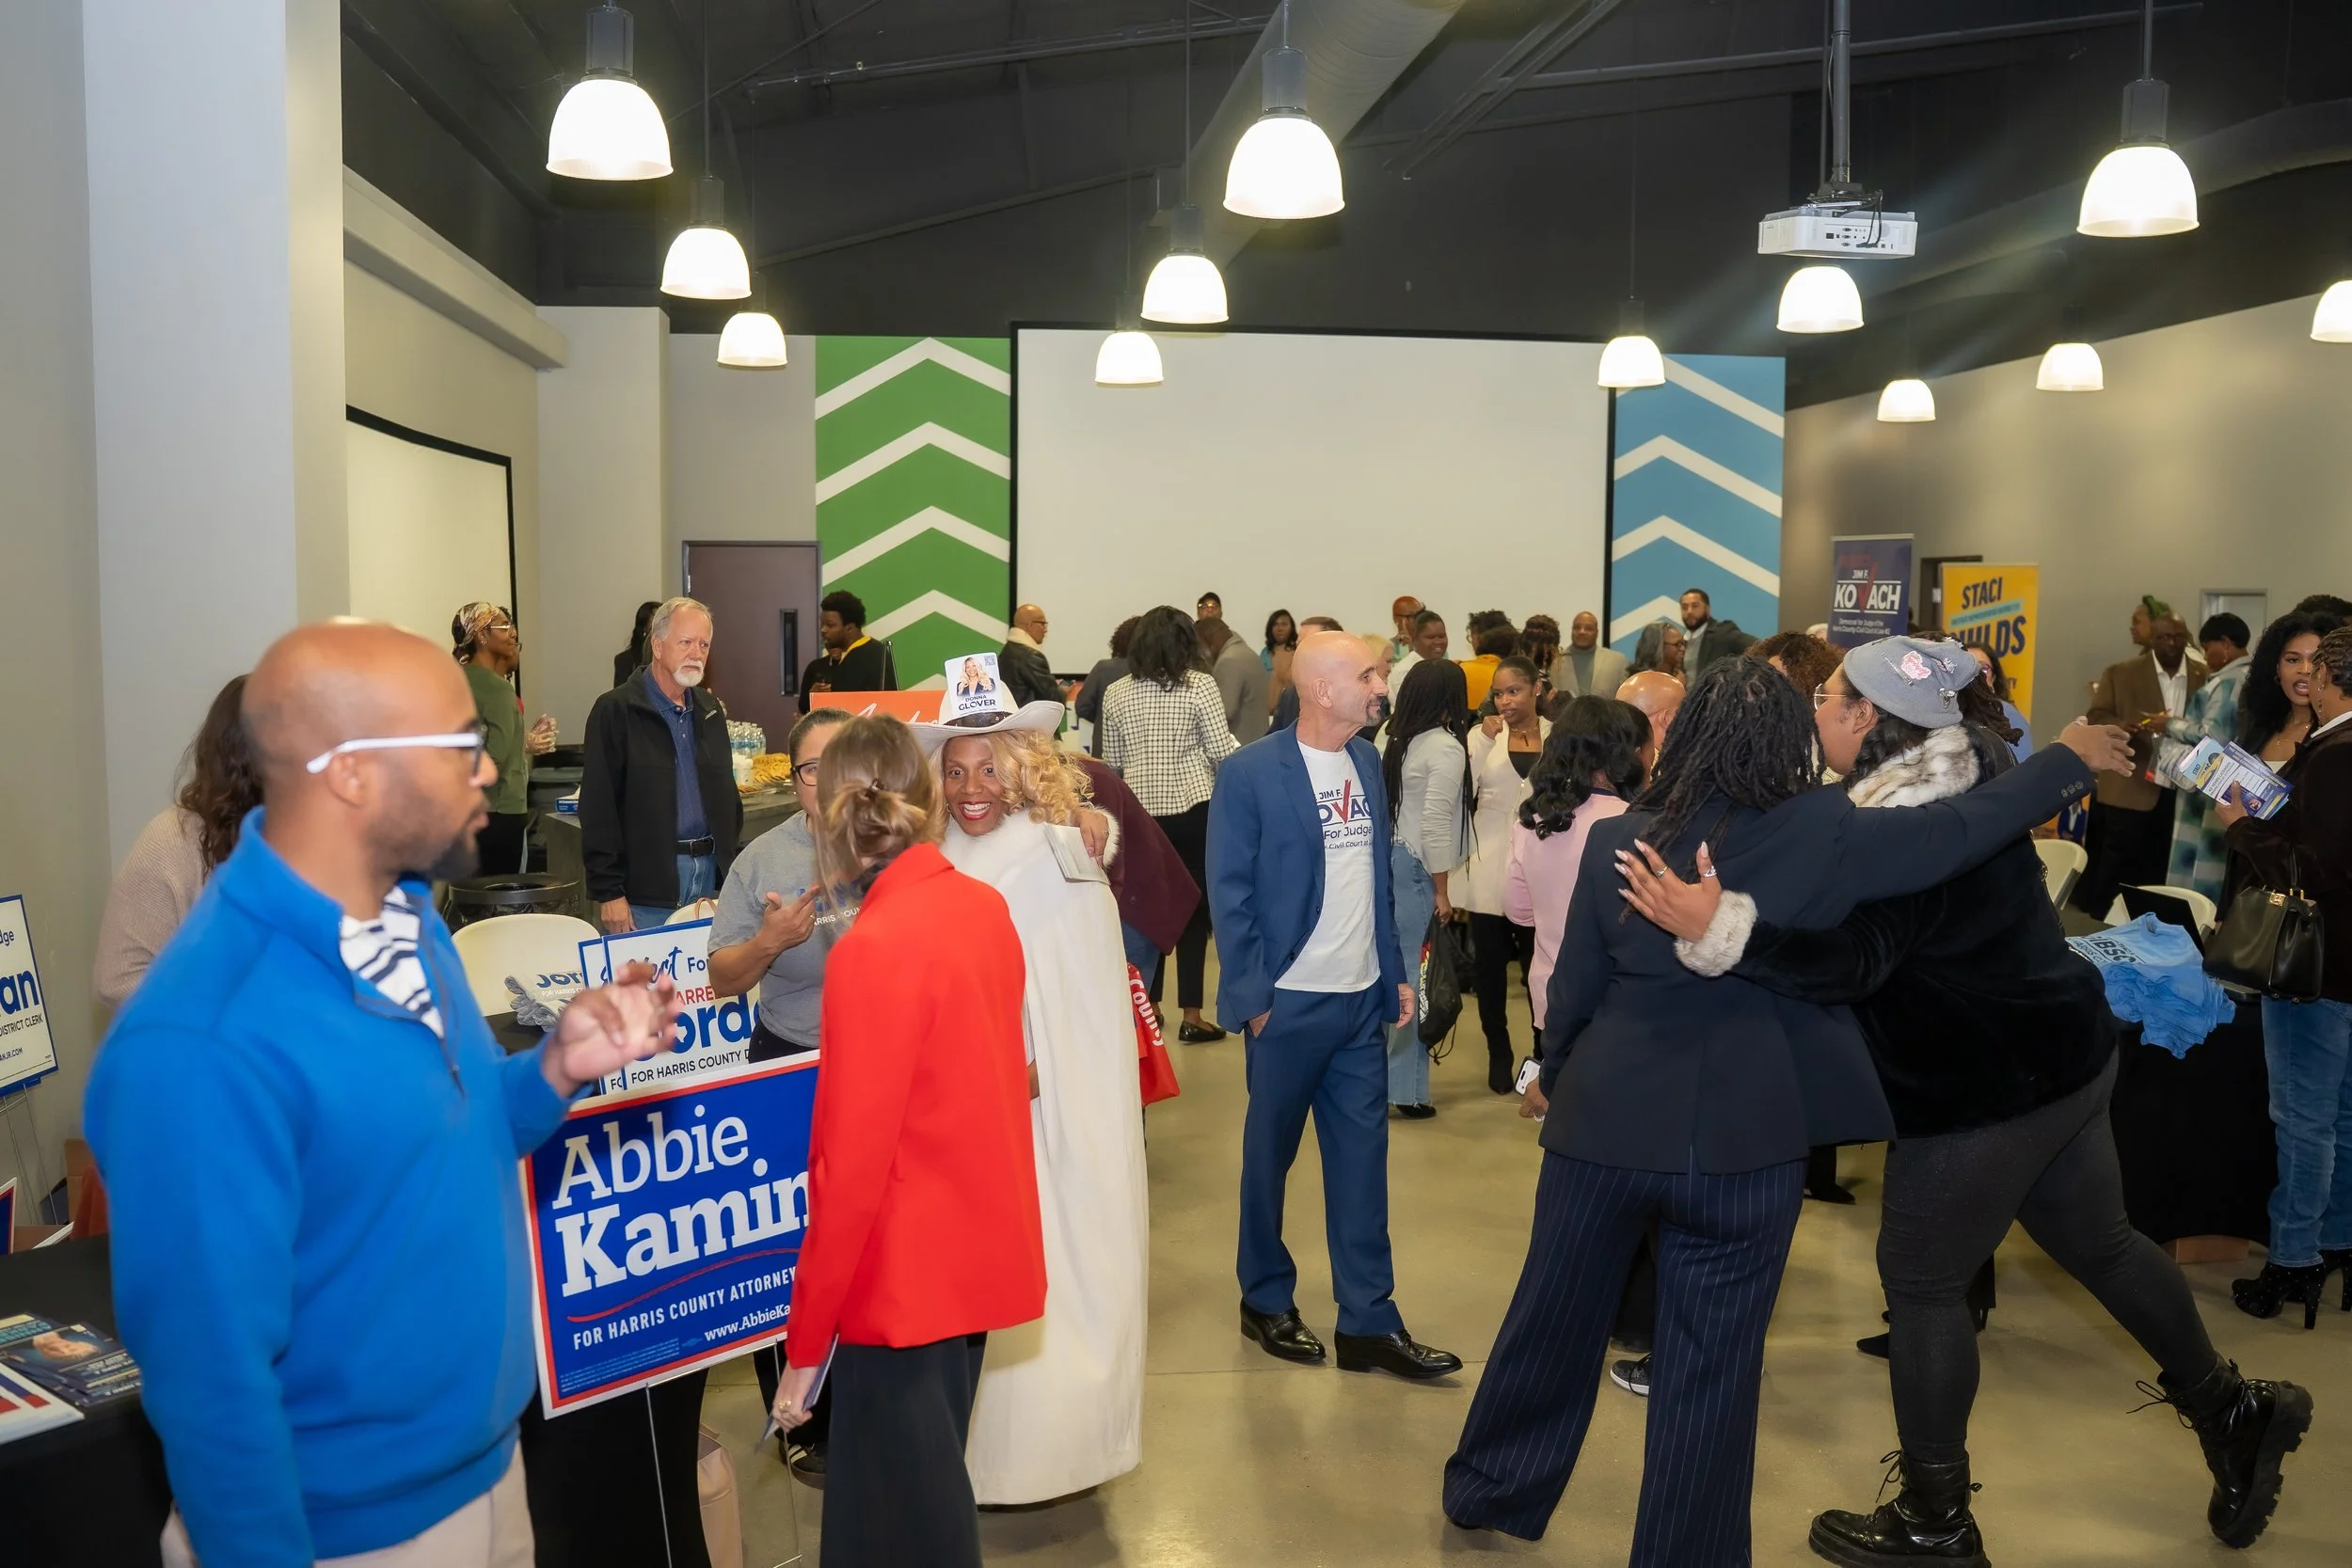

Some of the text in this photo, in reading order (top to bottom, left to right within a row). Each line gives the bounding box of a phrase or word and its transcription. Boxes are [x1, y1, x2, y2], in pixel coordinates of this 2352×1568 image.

[1962, 577, 2003, 610] STACI
[959, 700, 995, 710] GLOVER
[1319, 788, 1343, 800] JIM F.
[1324, 823, 1373, 840] For Judge
[1345, 839, 1363, 847] Court
[813, 914, 836, 926] ARRIS
[687, 957, 709, 974] Fo
[676, 985, 721, 1006] ARRE
[24, 1013, 43, 1028] CLERK
[630, 1069, 654, 1085] FOR
[656, 1060, 696, 1079] HARRIS
[698, 1050, 743, 1070] COUNTY
[552, 1104, 749, 1210] Abbie
[554, 1158, 809, 1298] Kamin
[573, 1266, 797, 1350] FOR HARRIS COUNTY ATTORNEY
[704, 1304, 791, 1342] www.AbbieKa
